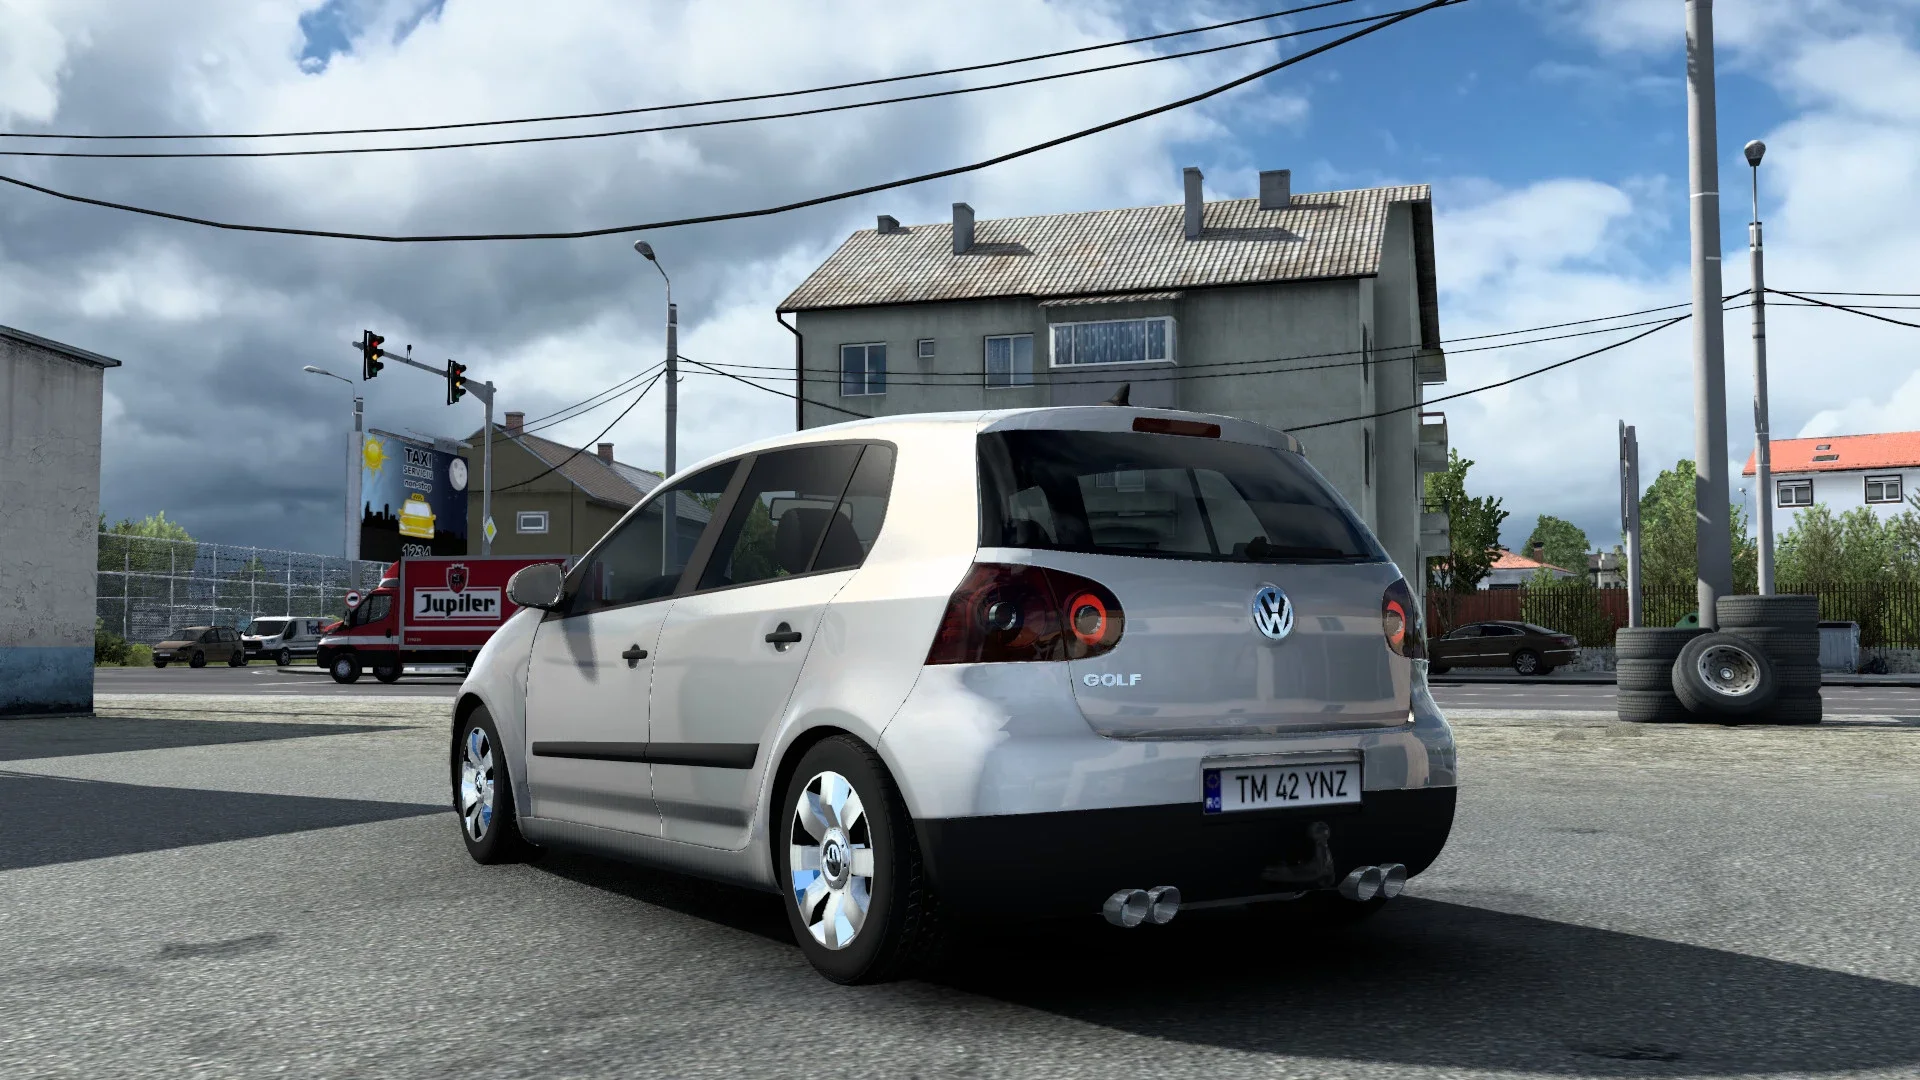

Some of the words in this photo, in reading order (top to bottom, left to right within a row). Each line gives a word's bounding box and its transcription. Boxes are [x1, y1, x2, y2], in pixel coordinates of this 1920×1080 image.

[404, 446, 432, 469] TAXI
[403, 465, 434, 480] SERVICIU
[404, 479, 432, 493] non-stop
[402, 543, 431, 556] 1234
[420, 593, 496, 617] Jupiler
[1083, 673, 1142, 687] GOLF
[1235, 774, 1268, 803] TM
[1275, 772, 1299, 800] 42
[1305, 769, 1347, 798] YNZ
